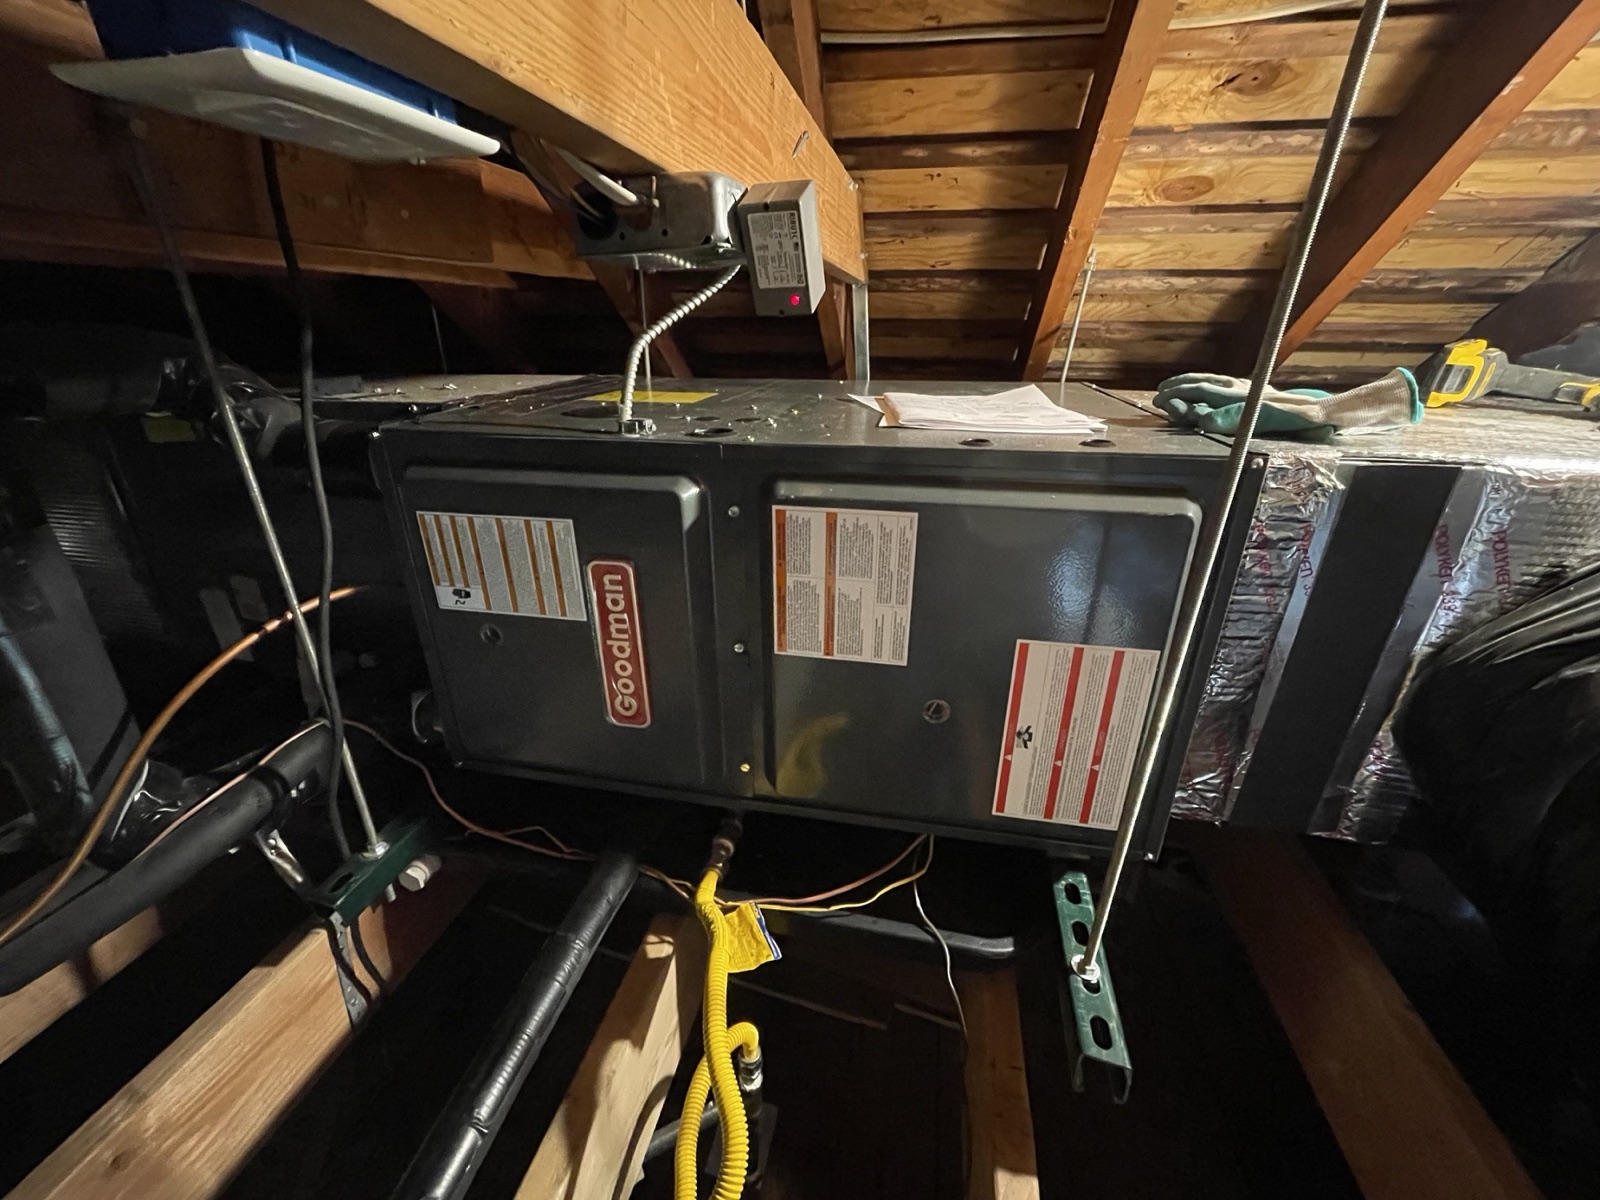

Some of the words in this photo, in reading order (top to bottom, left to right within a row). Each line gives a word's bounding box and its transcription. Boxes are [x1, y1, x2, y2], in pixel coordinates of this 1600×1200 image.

[788, 212, 798, 239] RIBU1C
[1492, 529, 1512, 592] POLYKEN
[603, 573, 638, 717] Goodman
